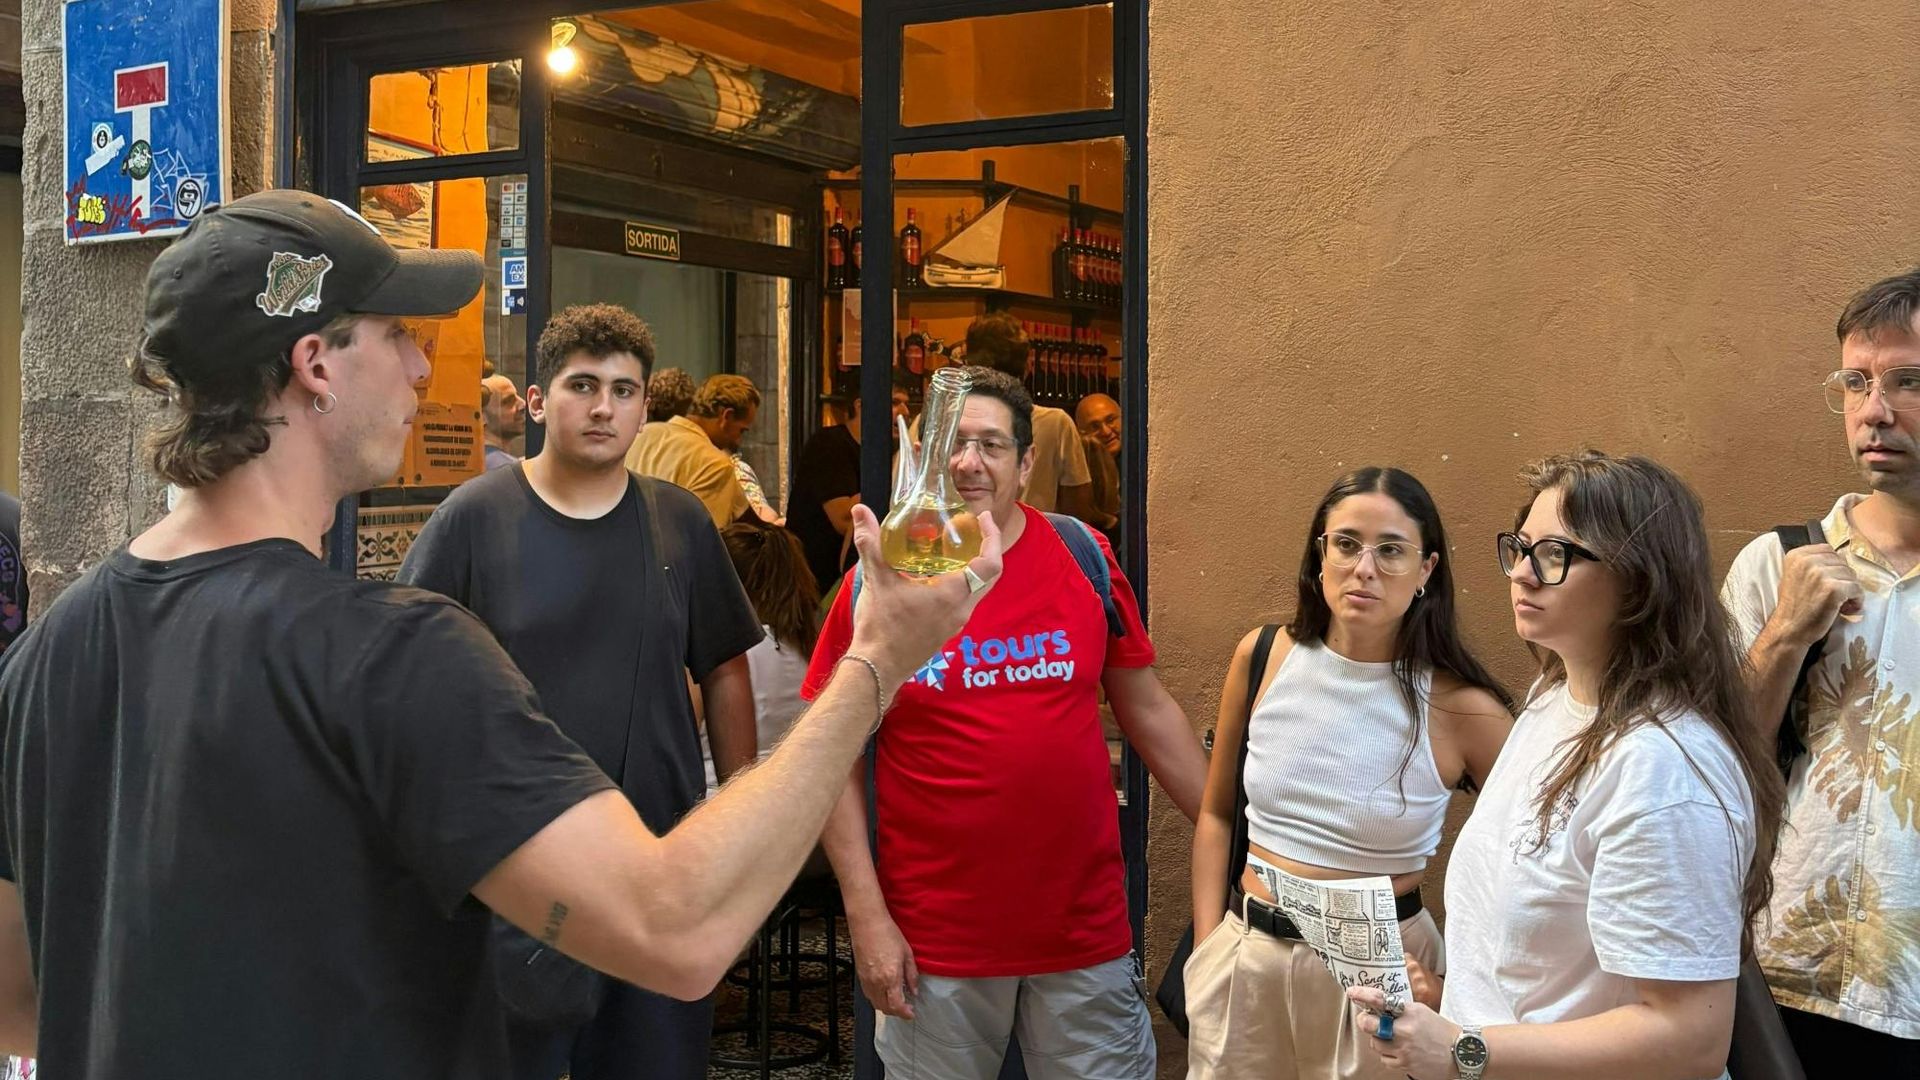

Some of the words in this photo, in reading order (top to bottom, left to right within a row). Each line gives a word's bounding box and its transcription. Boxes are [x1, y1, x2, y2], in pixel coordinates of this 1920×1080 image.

[628, 229, 677, 253] SORTIDA
[958, 629, 1071, 666] tours
[962, 667, 1000, 689] for
[1005, 657, 1075, 683] today
[1358, 970, 1386, 986] Send
[1387, 971, 1401, 982] it
